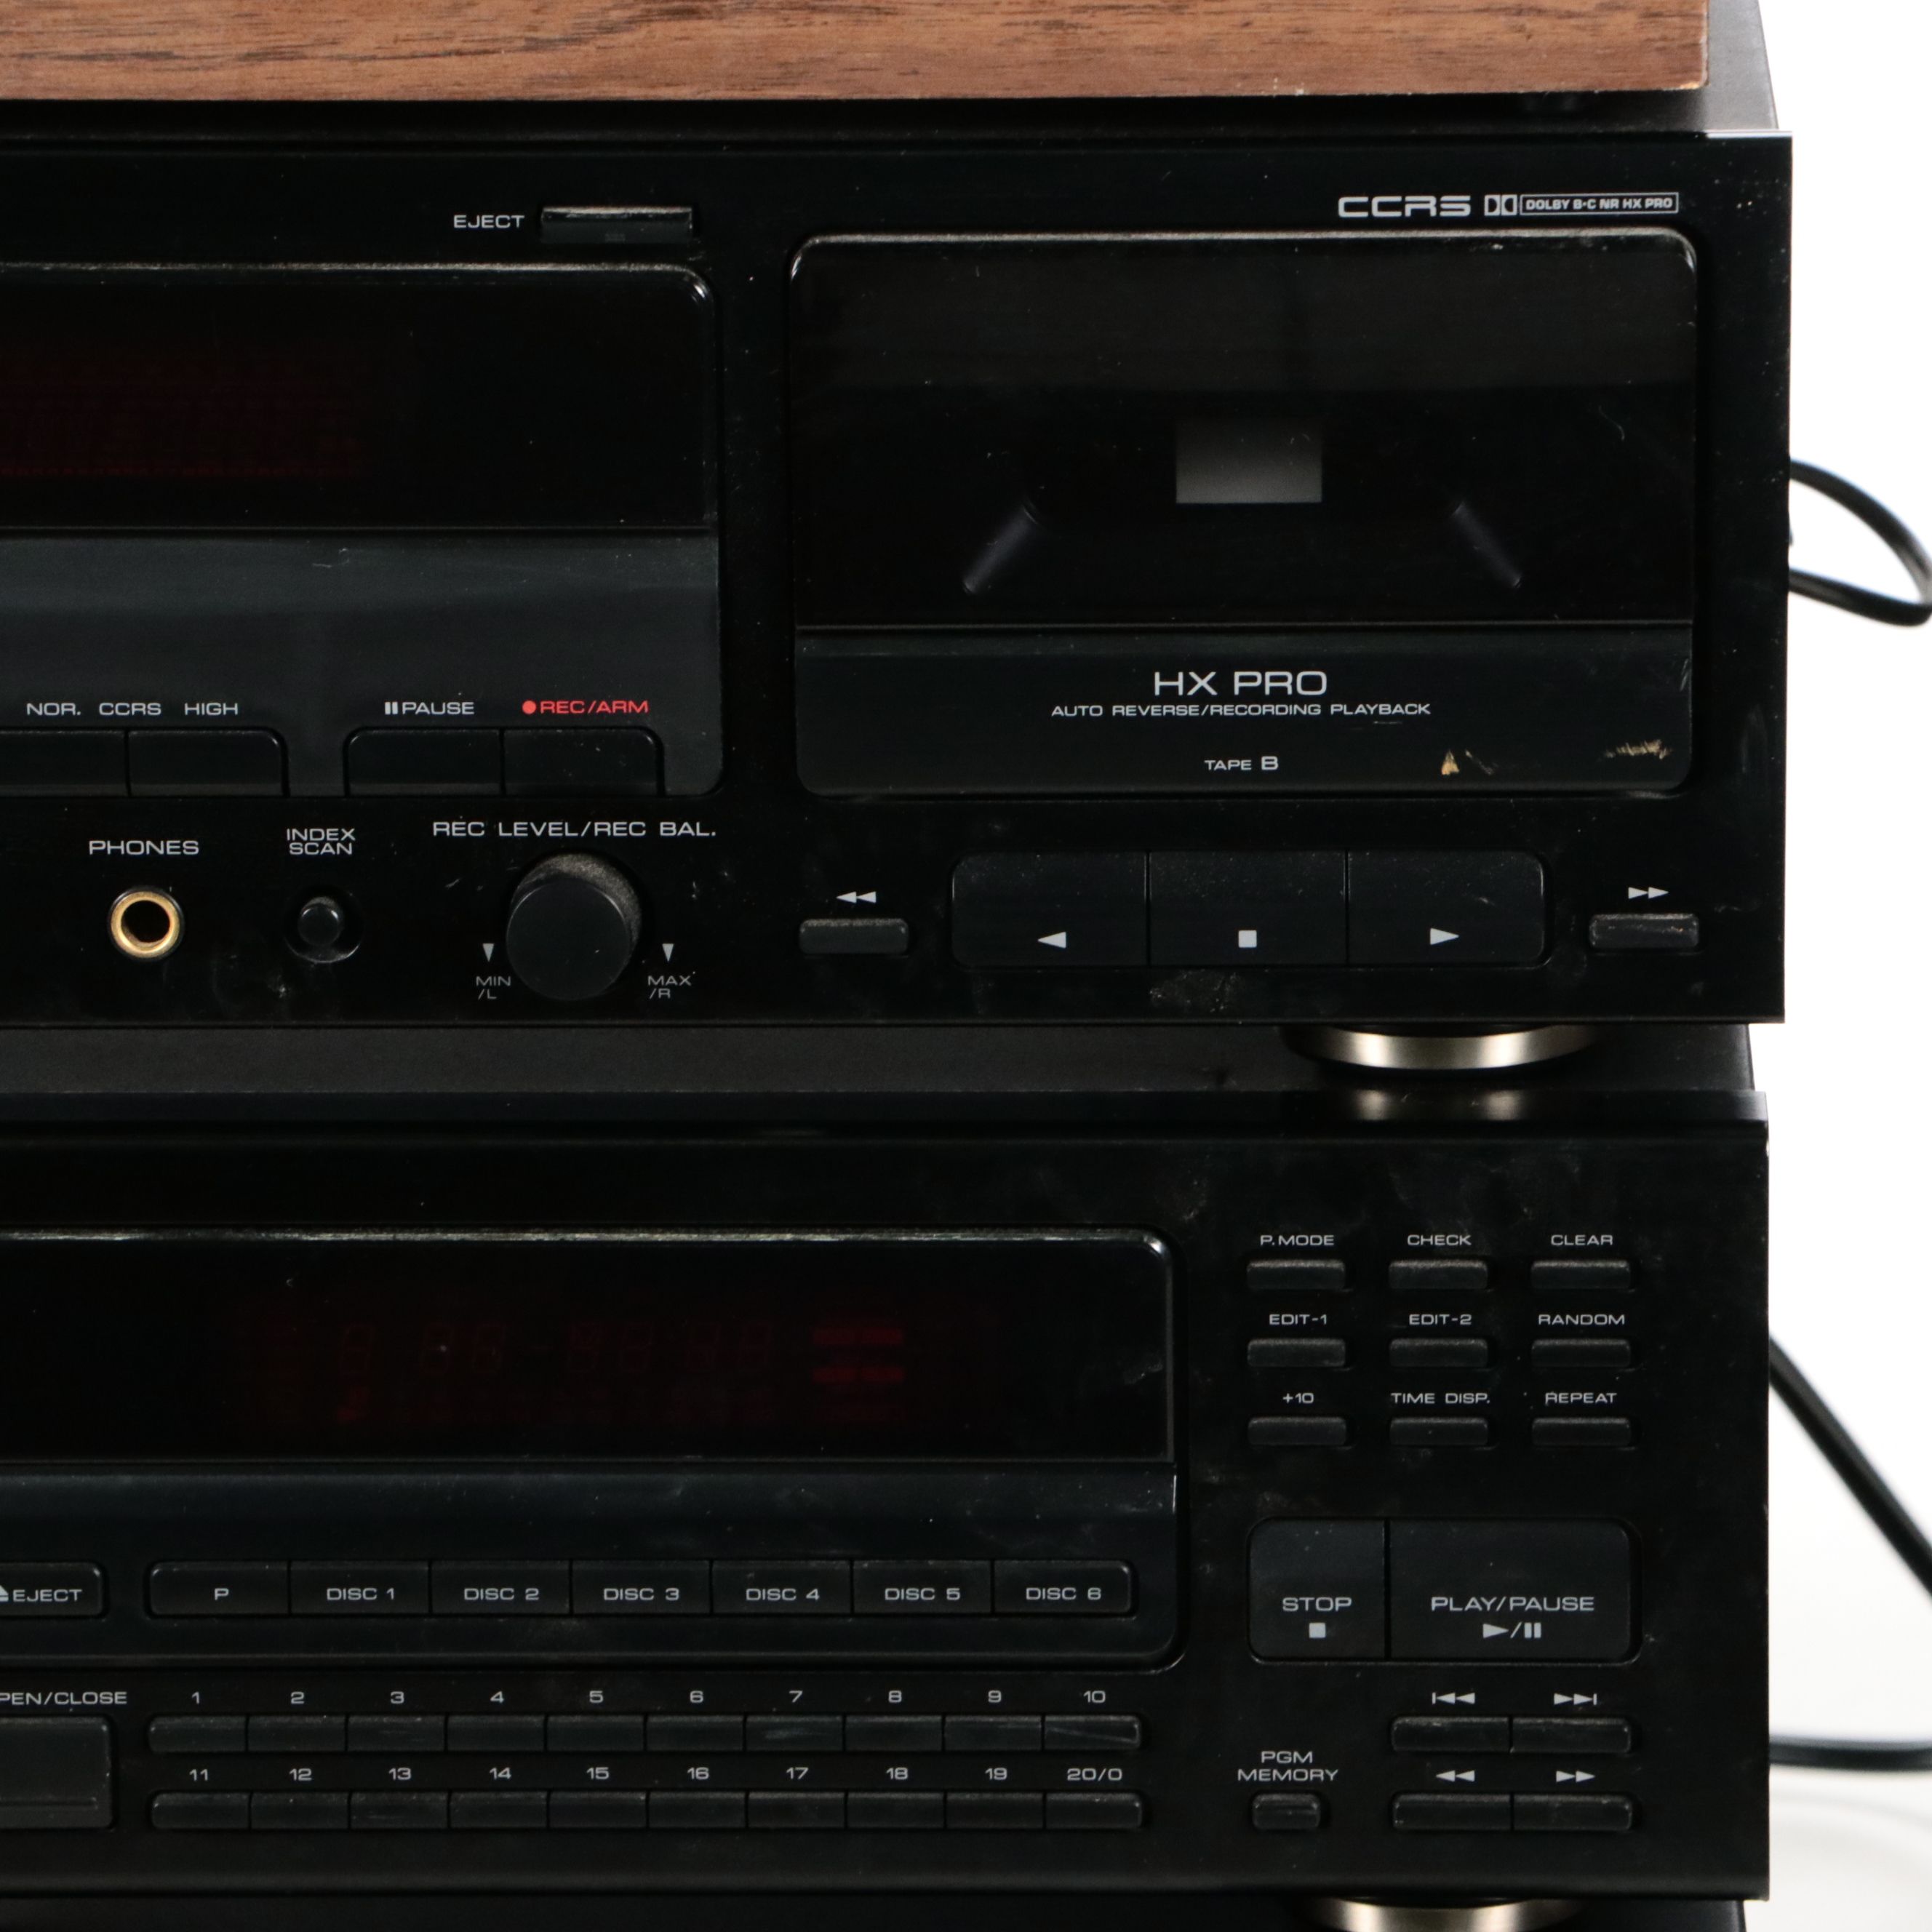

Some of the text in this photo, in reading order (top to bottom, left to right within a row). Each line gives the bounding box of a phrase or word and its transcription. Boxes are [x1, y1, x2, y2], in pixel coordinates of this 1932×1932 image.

[1338, 195, 1472, 218] CCRS
[1525, 199, 1570, 210] DOLBY
[1599, 198, 1620, 209] NR
[1622, 198, 1642, 209] HX
[1645, 197, 1673, 209] PRO
[453, 215, 525, 229] EJECT
[1154, 671, 1328, 696] HX PRO
[26, 702, 81, 716] NOR.
[98, 702, 161, 716] CCRS
[184, 702, 239, 716] HIGH
[402, 701, 475, 715] PAUSE
[540, 700, 649, 714] REC/ARM
[1051, 703, 1431, 717] AUTO REVERSE/RECORDING PLAYBACK
[1204, 756, 1279, 771] TAPE B
[286, 828, 356, 842] INDEX
[433, 821, 716, 837] REC LEVEL/REC BAL.
[89, 839, 199, 855] PHONES
[289, 842, 353, 855] SCAN
[476, 975, 511, 986] MIN
[647, 975, 691, 986] MAX
[478, 989, 497, 1000] /L
[649, 988, 671, 999] /R
[1260, 1234, 1335, 1246] P.MODE
[1407, 1234, 1472, 1246] CHECK
[1550, 1234, 1613, 1246] CLEAR
[1269, 1314, 1327, 1325] EDIT-1
[1408, 1314, 1472, 1325] EDIT-2
[1538, 1314, 1625, 1325] RANDOM
[1282, 1392, 1314, 1404] +10
[1390, 1392, 1490, 1405] TIME DISP.
[1545, 1392, 1617, 1405] REPEAT
[12, 1589, 82, 1602] EJECT
[214, 1587, 229, 1600] P
[326, 1587, 395, 1601] DISC 1
[463, 1587, 540, 1601] DISC 2
[603, 1587, 679, 1601] DISC 3
[746, 1588, 820, 1602] DISC 4
[885, 1587, 961, 1601] DISC 5
[1026, 1586, 1102, 1600] DISC 6
[1282, 1597, 1352, 1612] STOP
[1431, 1596, 1594, 1612] PLAY/PAUSE
[191, 1691, 200, 1704] 1
[290, 1691, 305, 1704] 2
[390, 1691, 405, 1704] 3
[490, 1691, 505, 1704] 4
[588, 1690, 604, 1704] 5
[690, 1690, 704, 1704] 6
[789, 1690, 803, 1703] 7
[888, 1690, 903, 1704] 8
[988, 1690, 1002, 1704] 9
[1083, 1690, 1106, 1704] 10
[1261, 1750, 1313, 1764] PGM
[189, 1768, 209, 1781] 11
[289, 1768, 312, 1781] 12
[388, 1767, 412, 1781] 13
[490, 1767, 512, 1780] 14
[586, 1766, 610, 1780] 15
[687, 1766, 710, 1781] 16
[786, 1766, 809, 1780] 17
[886, 1767, 909, 1781] 18
[985, 1767, 1007, 1781] 19
[1066, 1768, 1123, 1781] 20/0
[1237, 1768, 1338, 1781] MEMORY
